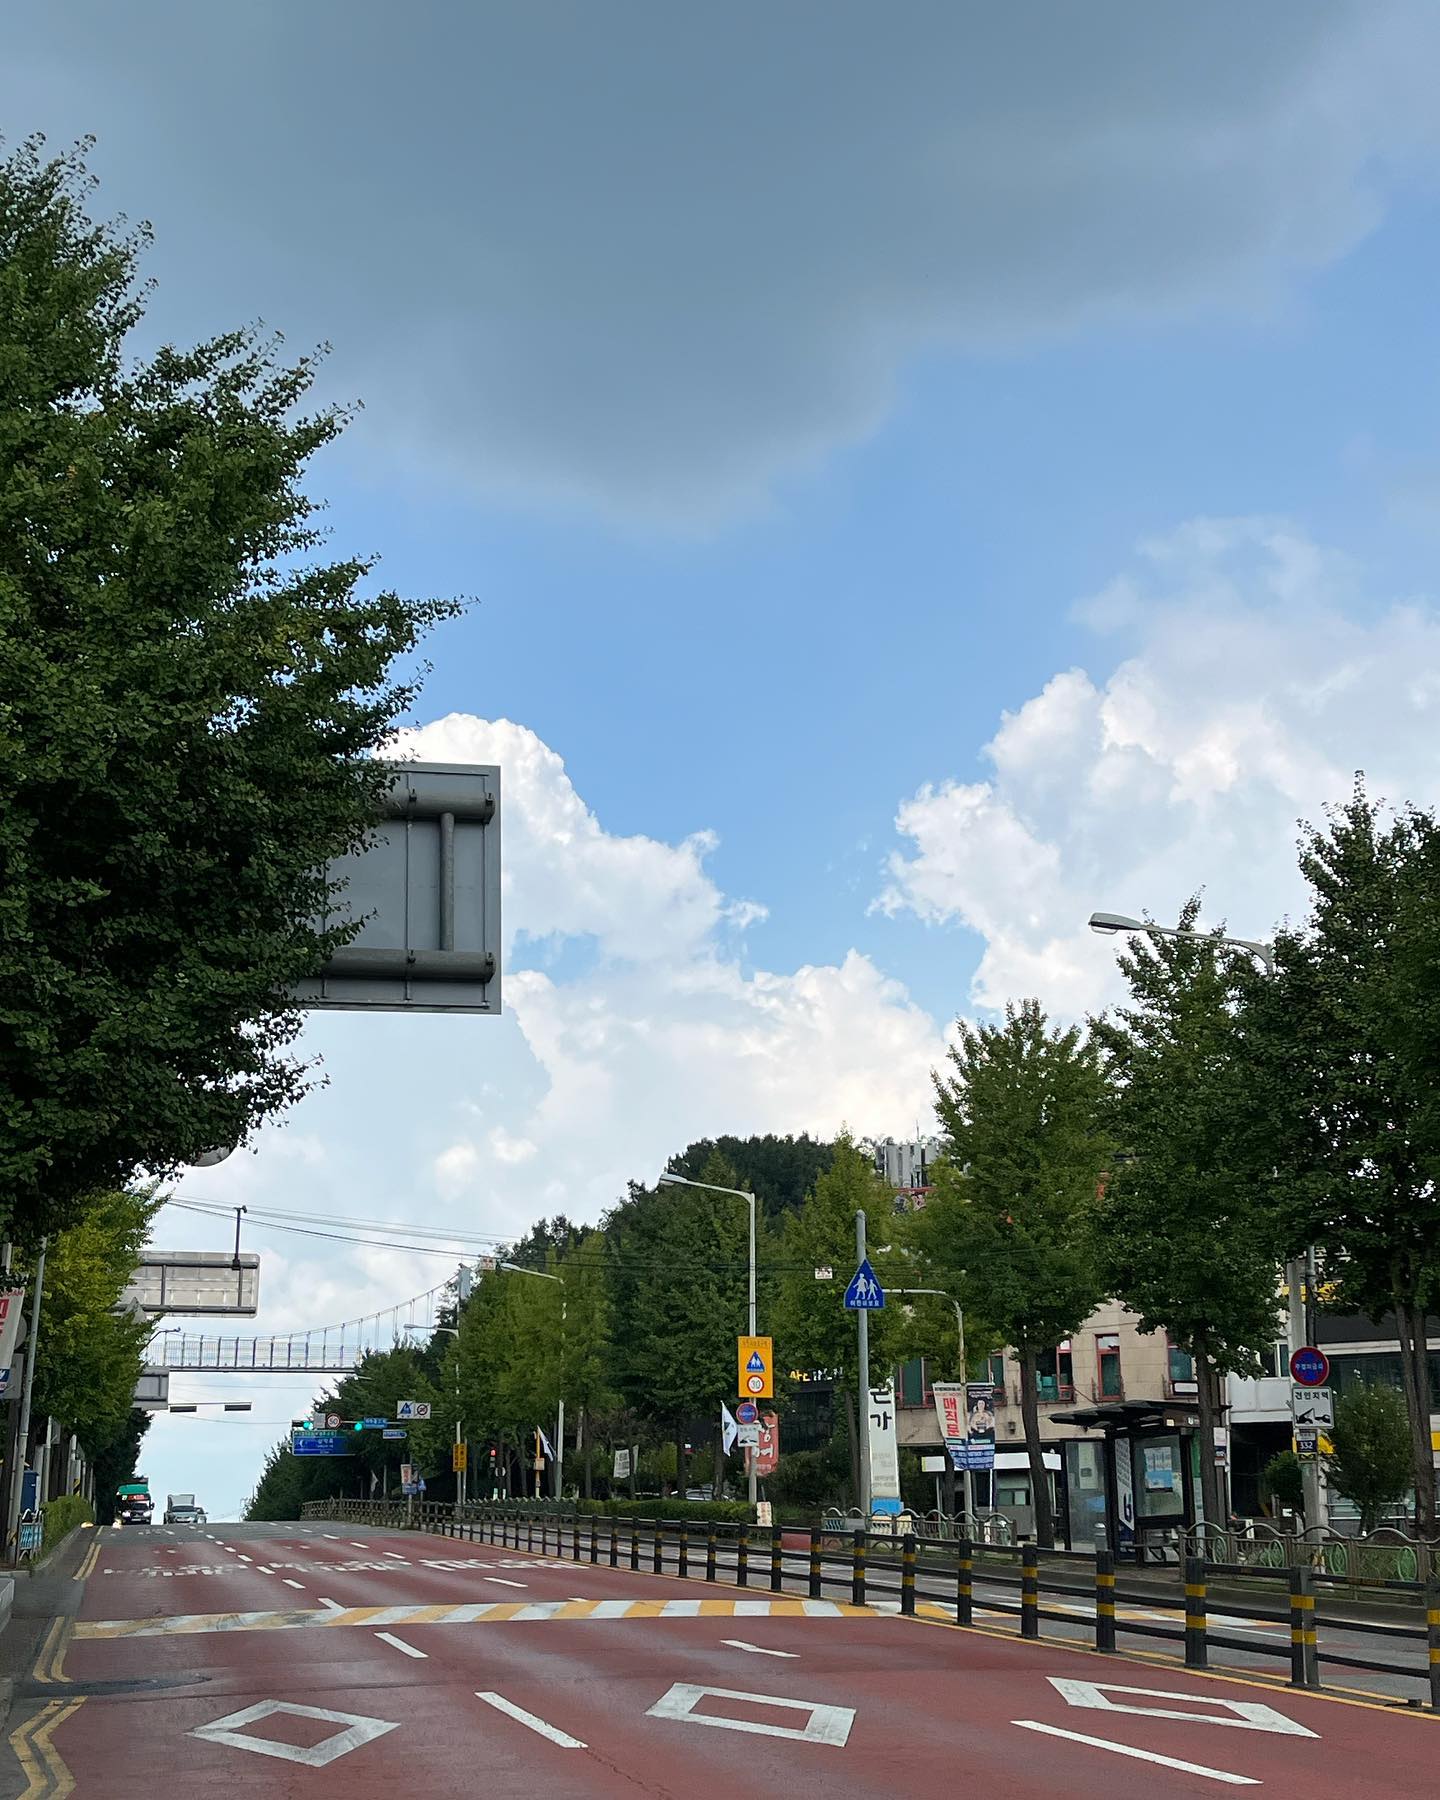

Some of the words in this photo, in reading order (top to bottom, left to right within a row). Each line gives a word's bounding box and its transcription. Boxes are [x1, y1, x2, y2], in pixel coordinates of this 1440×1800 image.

[750, 1379, 761, 1390] 30
[1295, 1391, 1329, 1400] 견인지역
[329, 1417, 338, 1425] 50
[1299, 1441, 1313, 1450] 332
